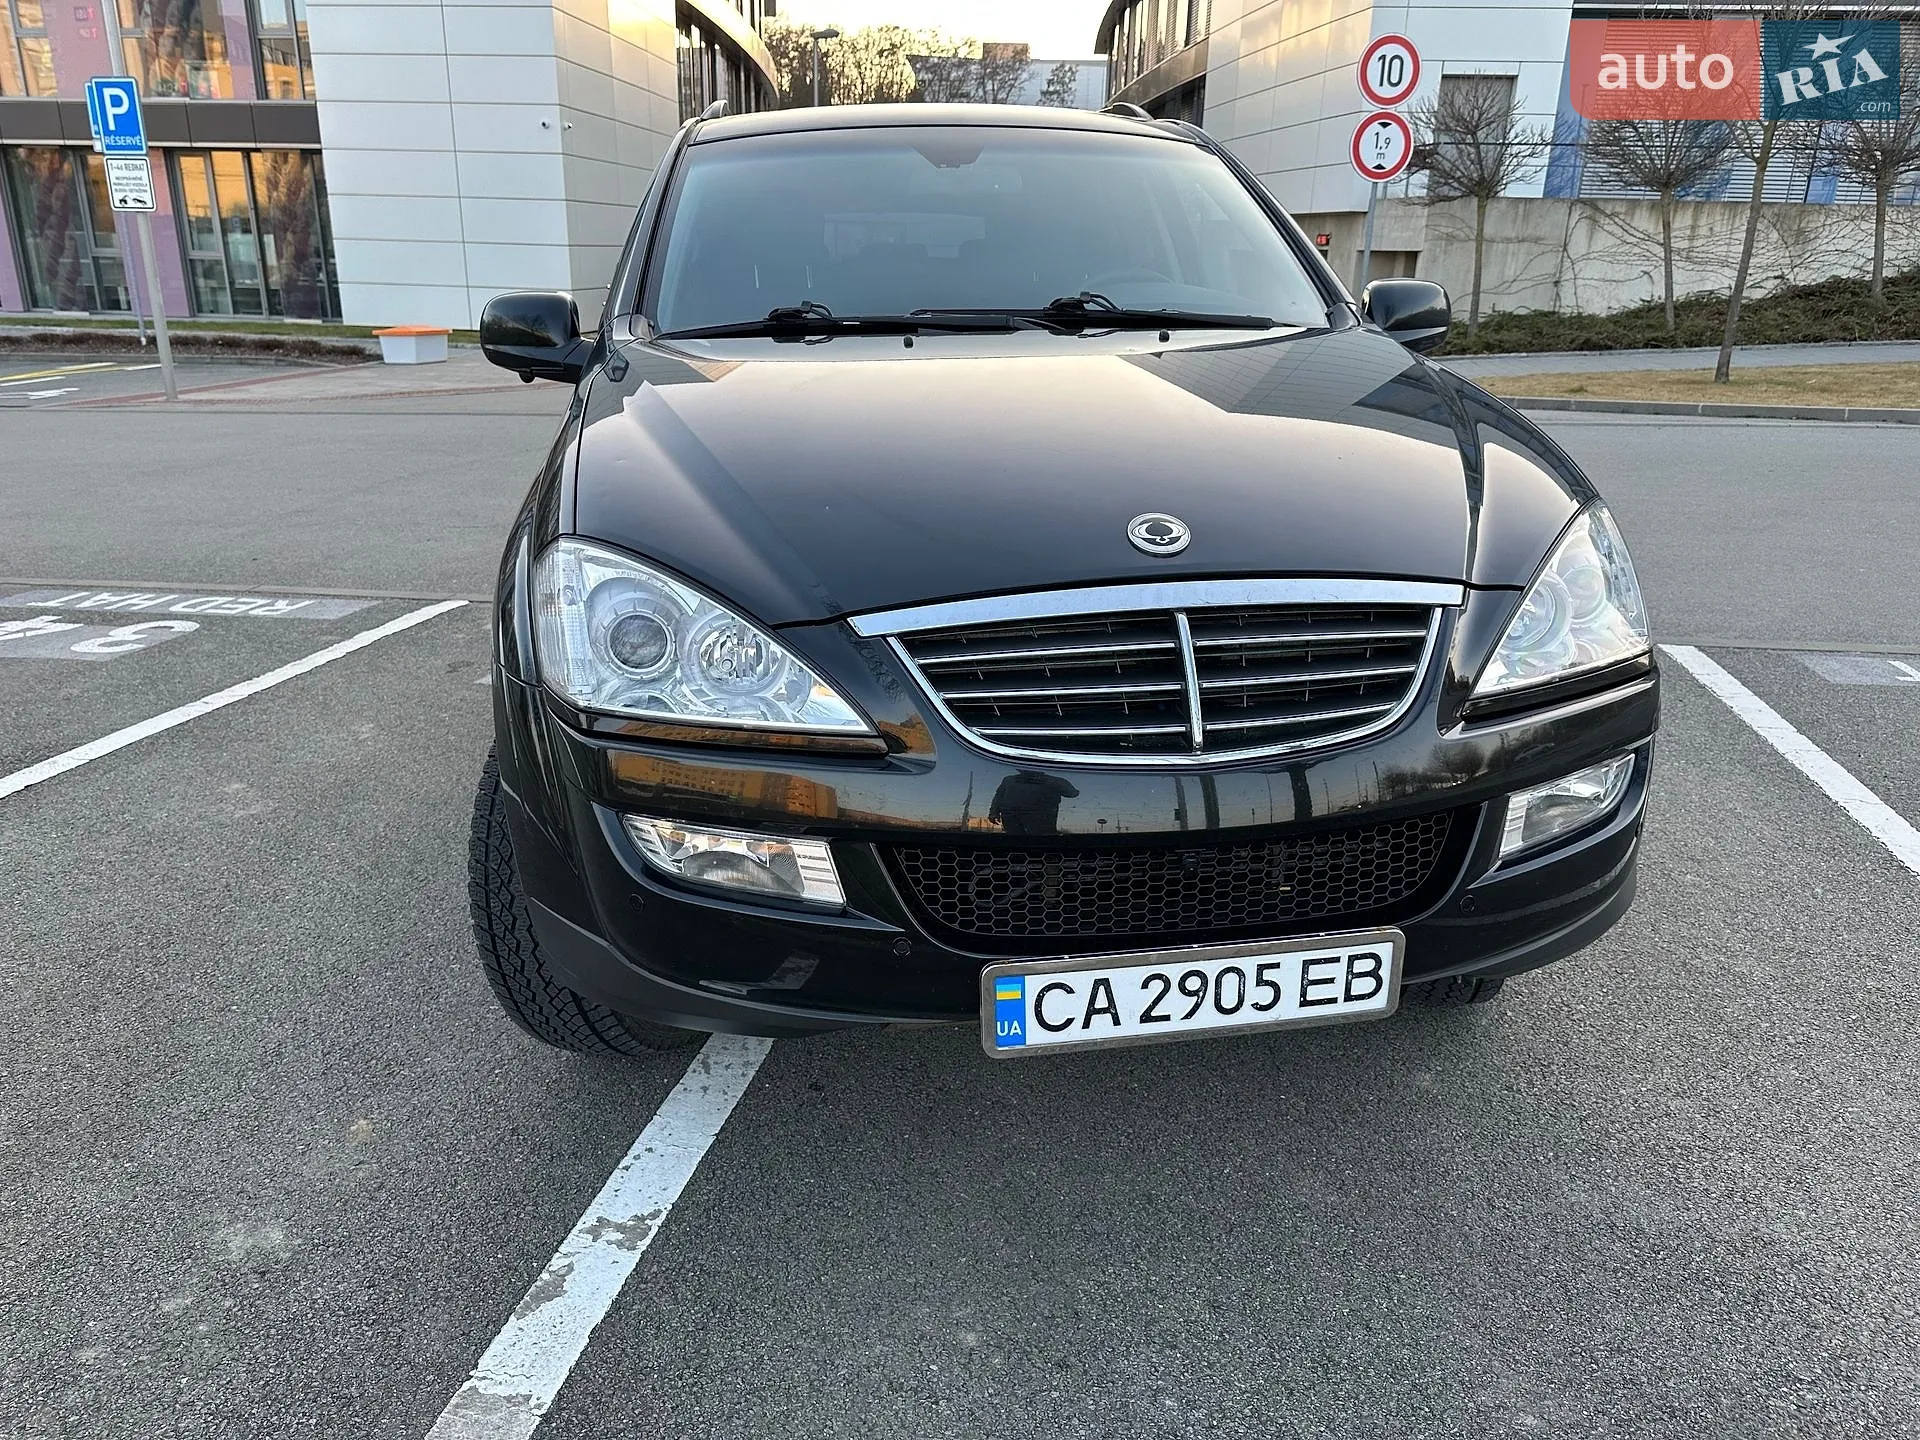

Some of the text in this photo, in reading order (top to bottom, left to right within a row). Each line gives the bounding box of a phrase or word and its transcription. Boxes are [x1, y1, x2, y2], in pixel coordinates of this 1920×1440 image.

[1377, 54, 1404, 88] 10
[102, 87, 130, 131] P
[1376, 152, 1386, 160] m
[26, 591, 316, 615] RED HAT
[1034, 951, 1384, 1033] CA 2905 EB
[996, 1021, 1023, 1037] UA
